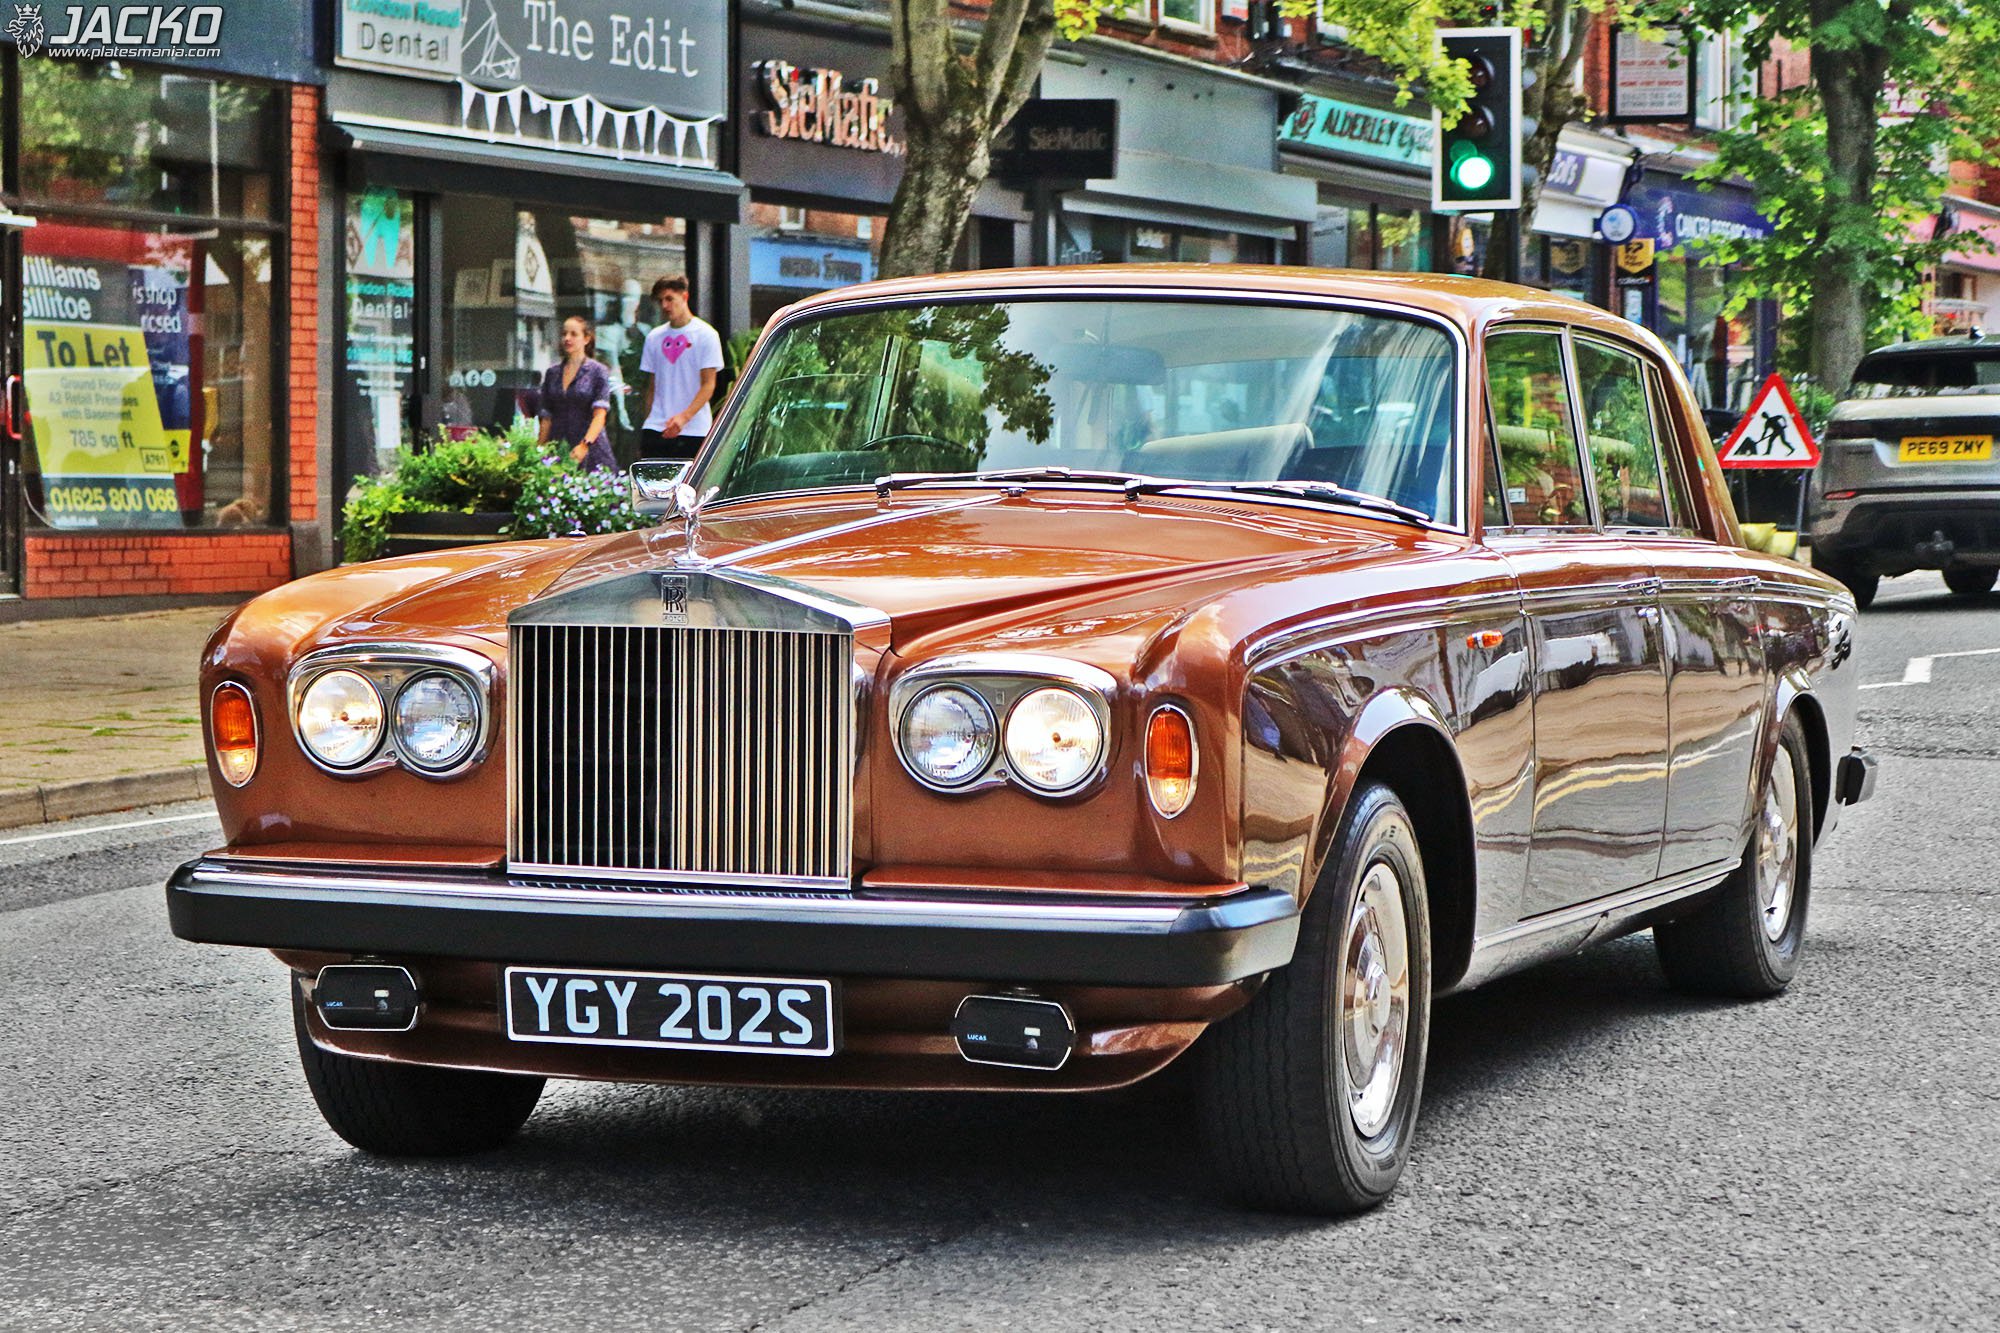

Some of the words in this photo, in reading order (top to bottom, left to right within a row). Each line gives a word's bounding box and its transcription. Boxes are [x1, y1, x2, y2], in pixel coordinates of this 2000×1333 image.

[359, 22, 450, 61] Dental
[524, 1, 594, 61] The
[609, 15, 699, 78] Edit
[754, 59, 904, 156] SieMatic
[1028, 127, 1107, 150] SieMatic
[1322, 108, 1399, 145] ALDERLEY
[145, 285, 178, 309] shop
[351, 297, 409, 320] Dental
[36, 330, 76, 368] To
[84, 332, 131, 368] Let
[69, 429, 97, 448] 785
[101, 434, 119, 451] sq
[121, 431, 135, 449] ft
[1907, 440, 1949, 456] PE69
[1953, 439, 1985, 454] ZMY
[50, 486, 106, 513] 01625
[108, 486, 143, 513] 800
[525, 976, 638, 1037] YGY
[658, 982, 814, 1046] 202S
[966, 1033, 987, 1042] LUCAS
